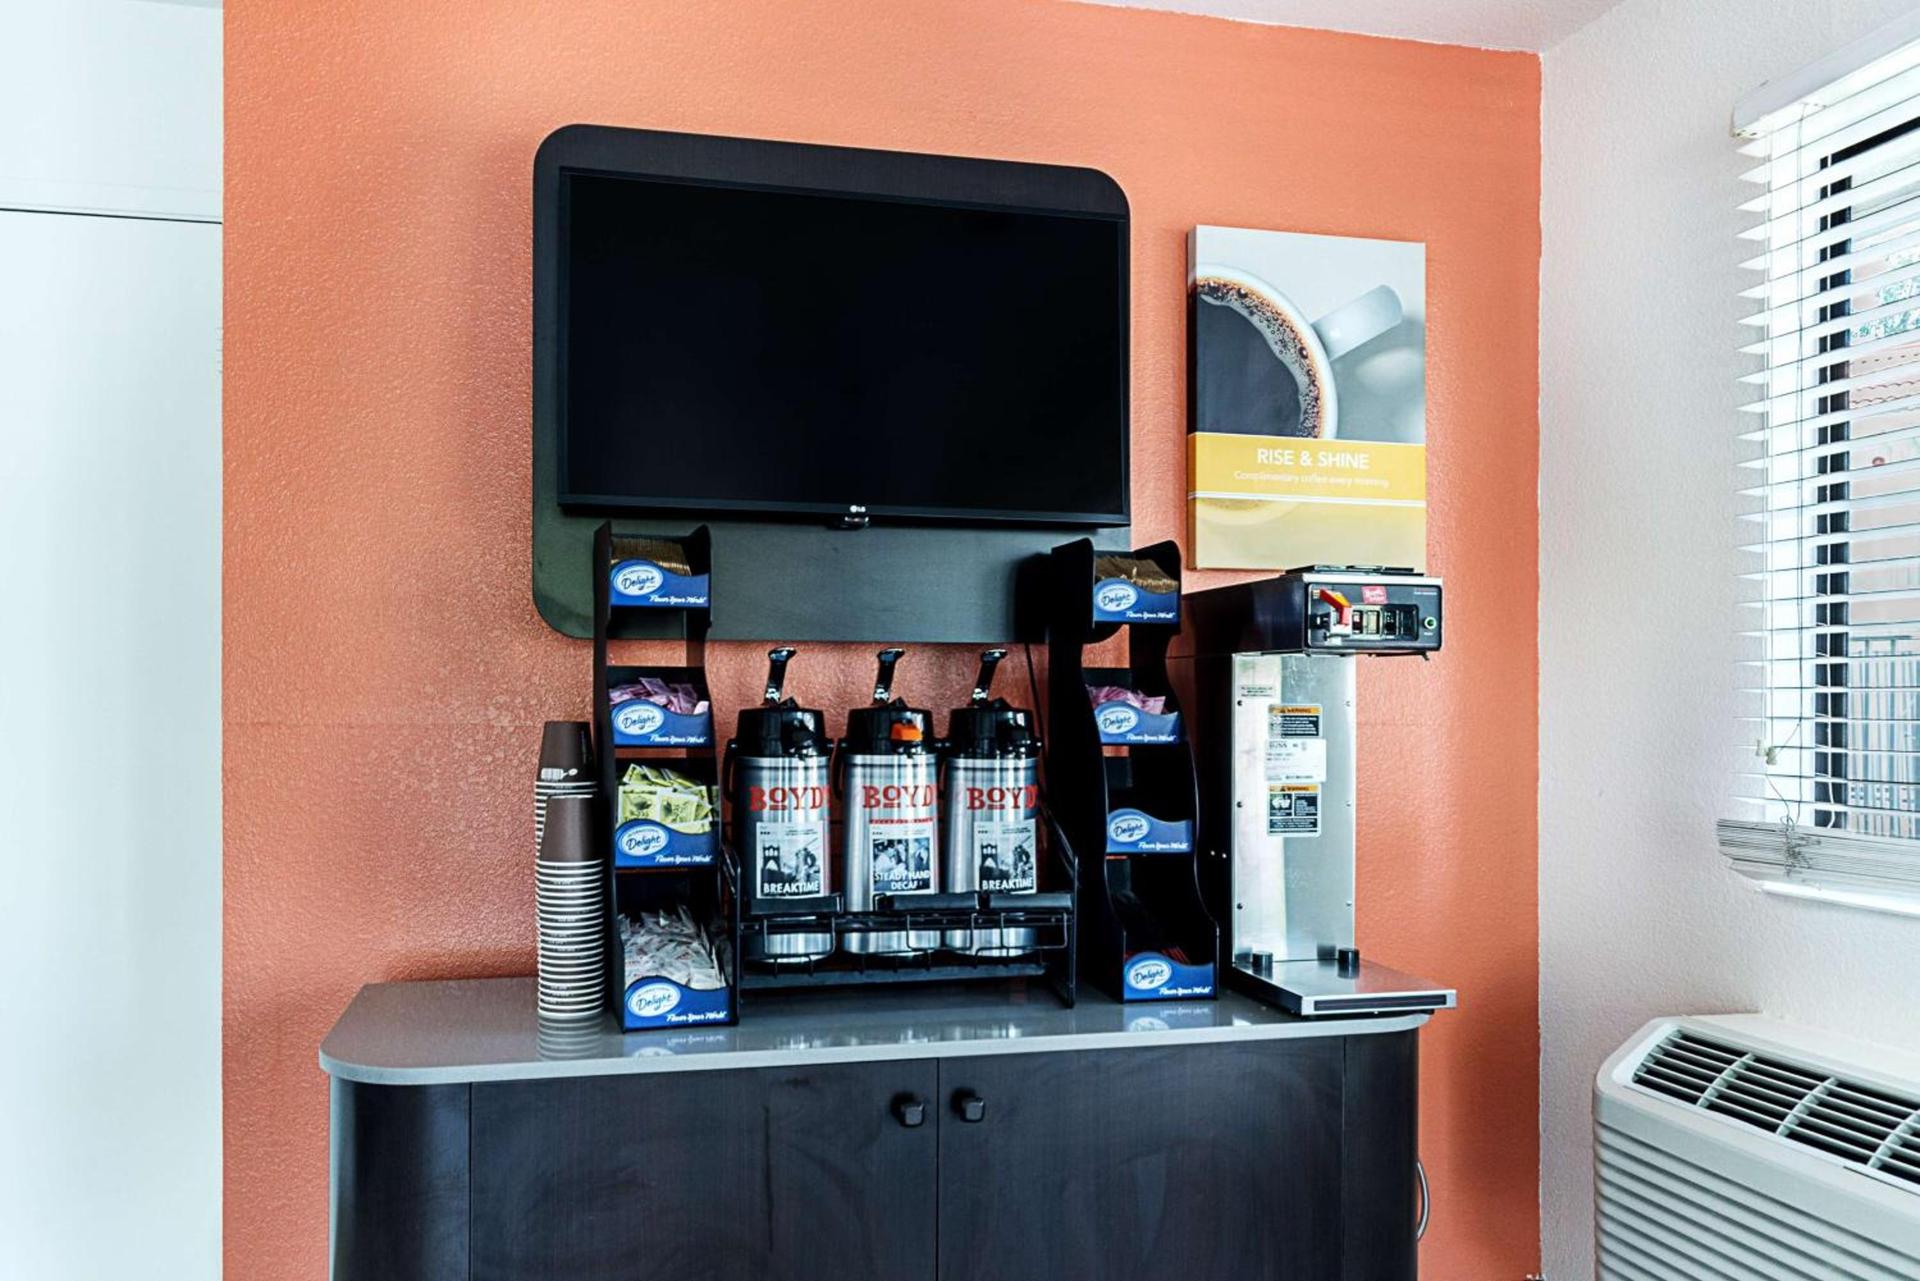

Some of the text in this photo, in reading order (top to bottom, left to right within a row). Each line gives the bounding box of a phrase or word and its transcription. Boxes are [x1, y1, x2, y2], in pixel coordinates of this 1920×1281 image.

[1257, 447, 1370, 470] RISE & SHINE
[621, 574, 656, 591] Delight
[1101, 593, 1131, 607] Delight
[621, 713, 656, 730] Delight
[1113, 823, 1144, 838] Delight
[625, 834, 661, 851] Delight
[763, 881, 820, 895] BREAKTIME
[890, 880, 919, 890] DECAF
[982, 877, 1034, 891] BREAKTIME
[1134, 968, 1165, 985] Delight
[635, 993, 672, 1012] Delight
